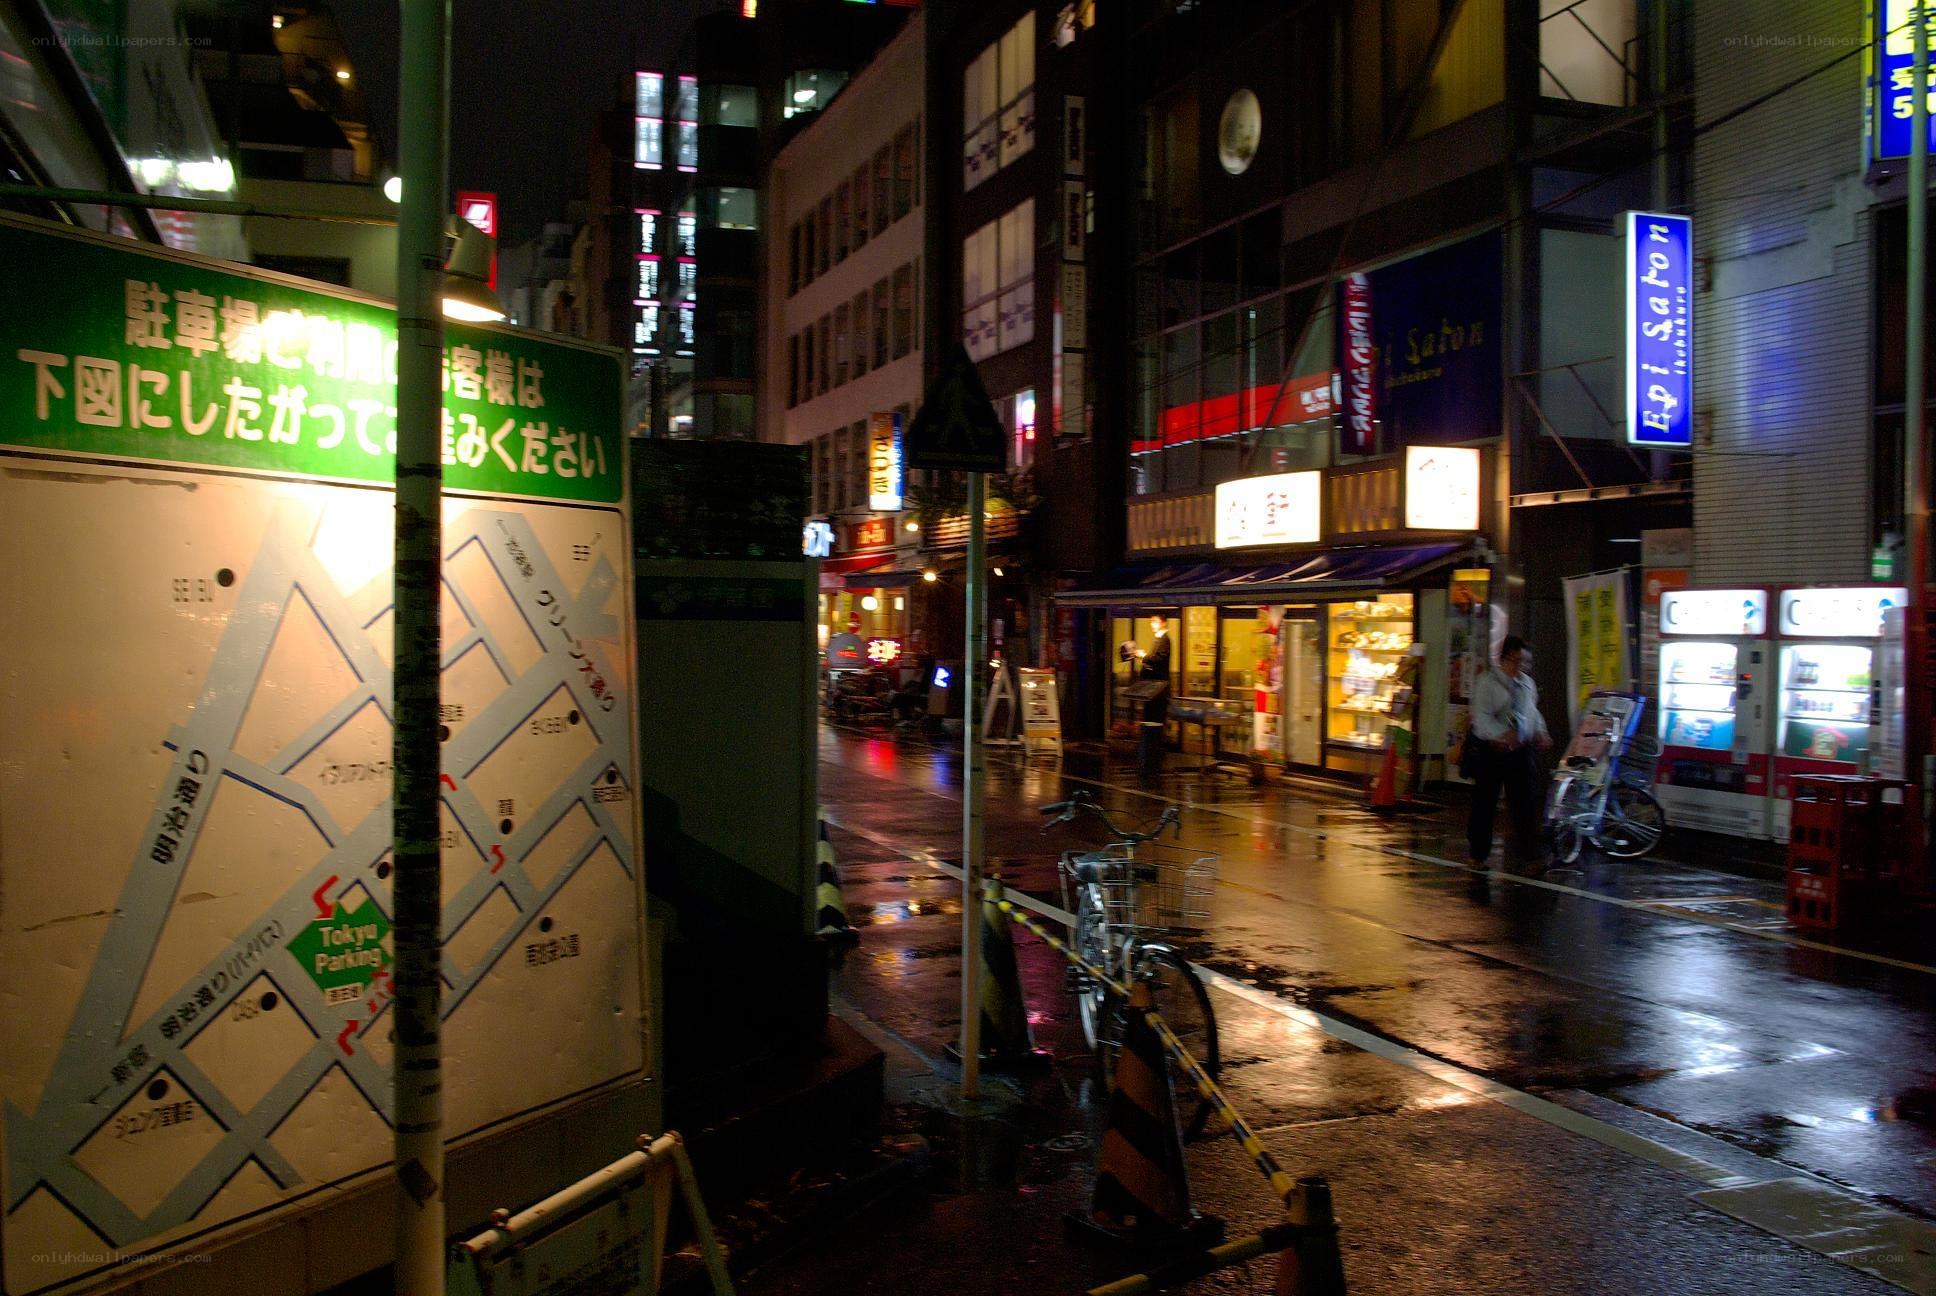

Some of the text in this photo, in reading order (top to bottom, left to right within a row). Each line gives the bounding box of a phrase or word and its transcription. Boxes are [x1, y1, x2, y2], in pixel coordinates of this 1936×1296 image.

[123, 278, 546, 409] 駐車場ご利用客様は
[16, 347, 607, 478] 下図にしたがってみください
[1641, 363, 1678, 434] Epi
[314, 946, 383, 974] Parking
[317, 923, 378, 949] Tokyu
